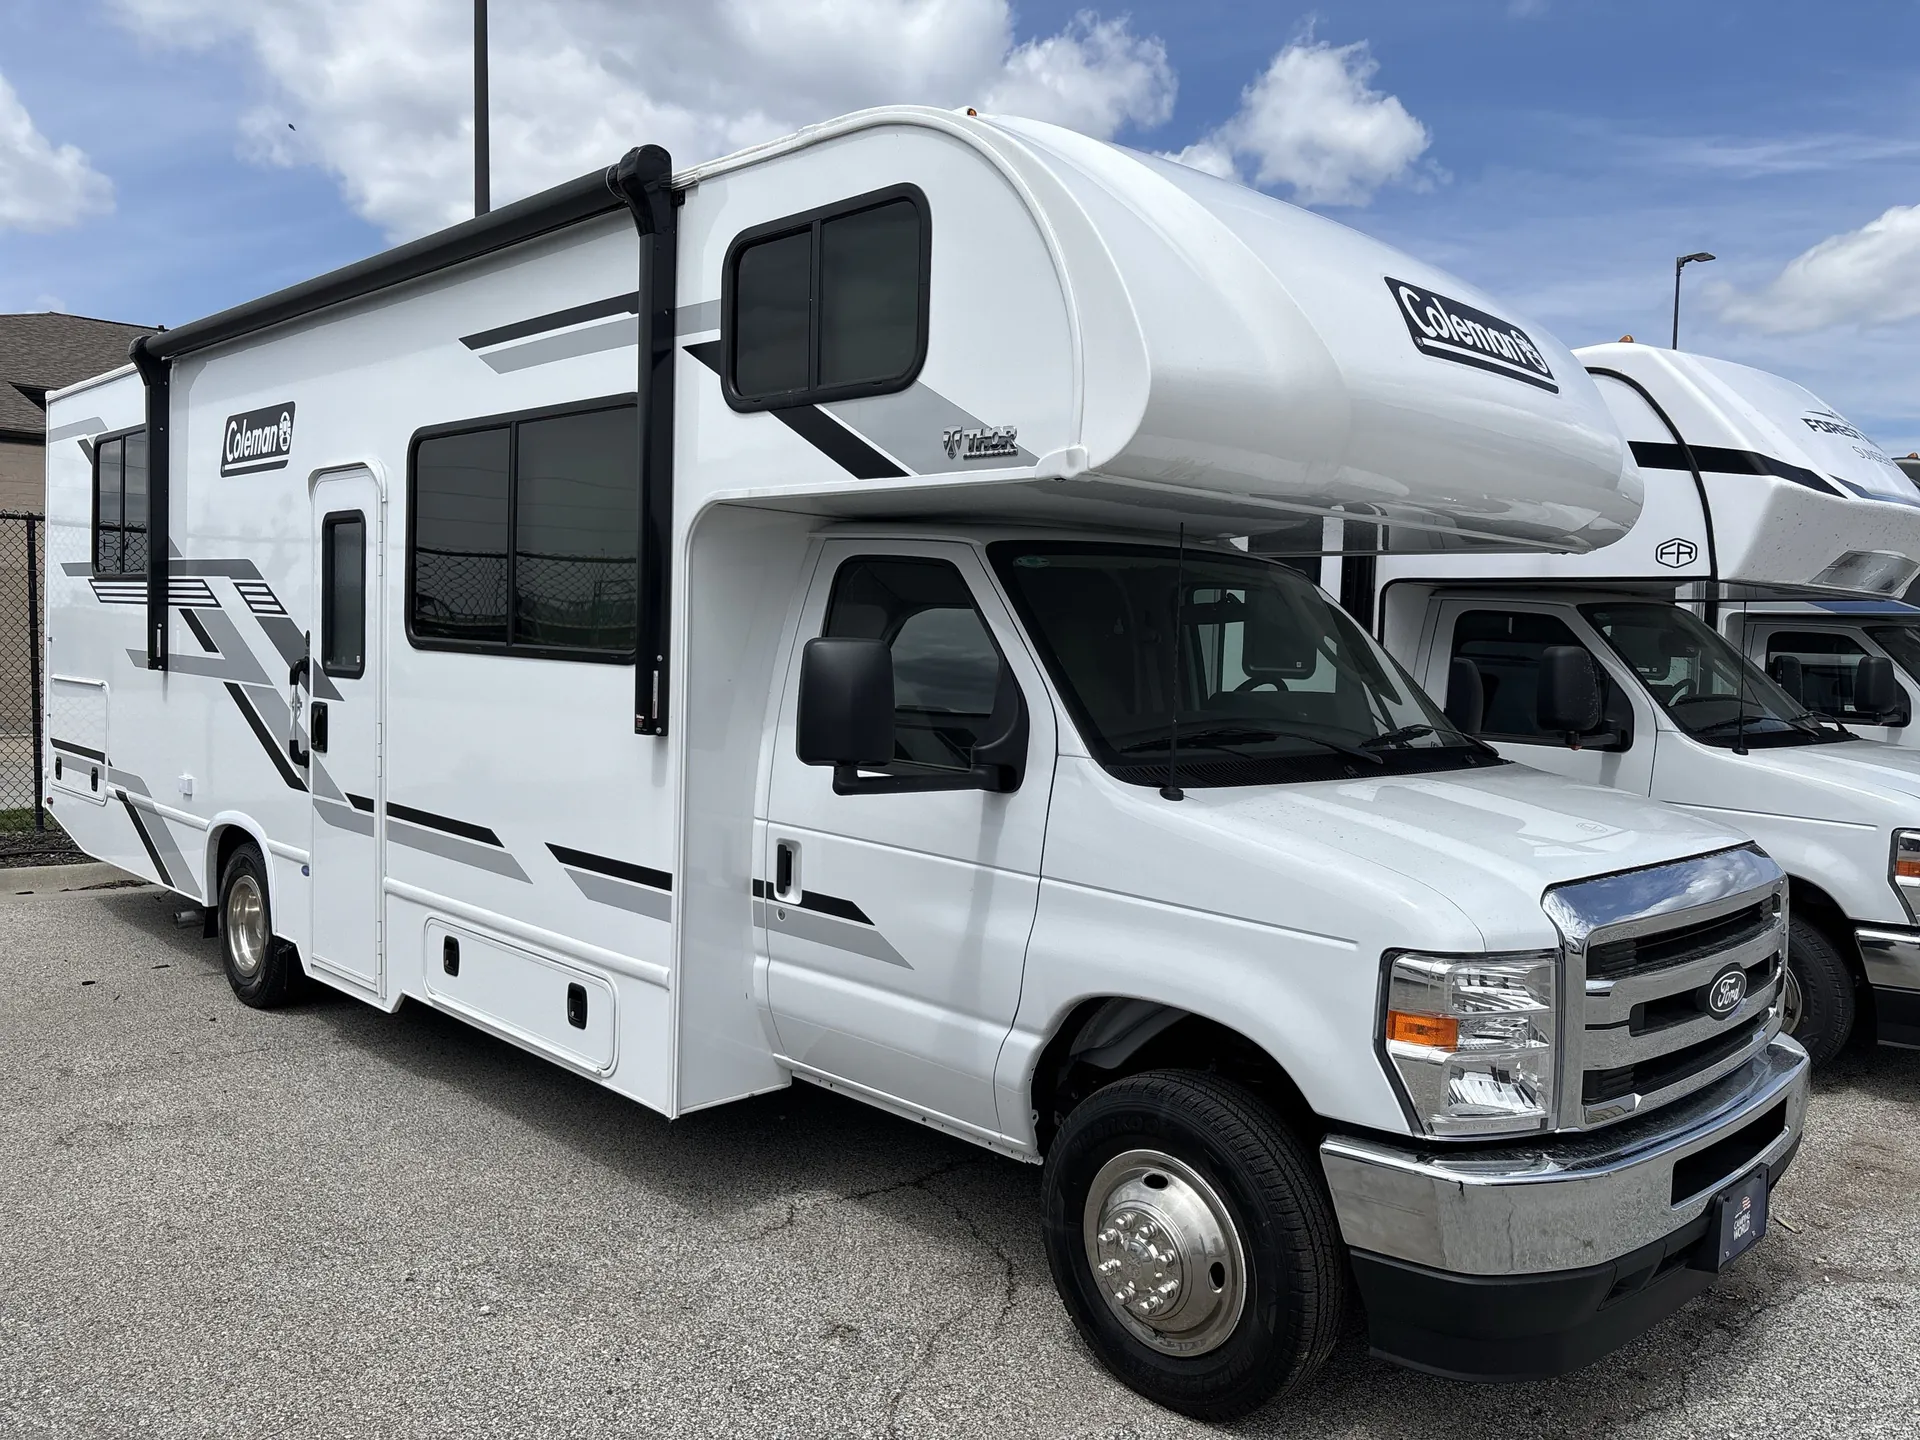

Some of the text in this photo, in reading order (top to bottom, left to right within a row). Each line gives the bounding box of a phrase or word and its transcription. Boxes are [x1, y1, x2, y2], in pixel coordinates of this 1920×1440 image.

[1399, 285, 1528, 365] Coleman
[226, 418, 279, 463] Coleman
[1717, 977, 1741, 1008] Ford
